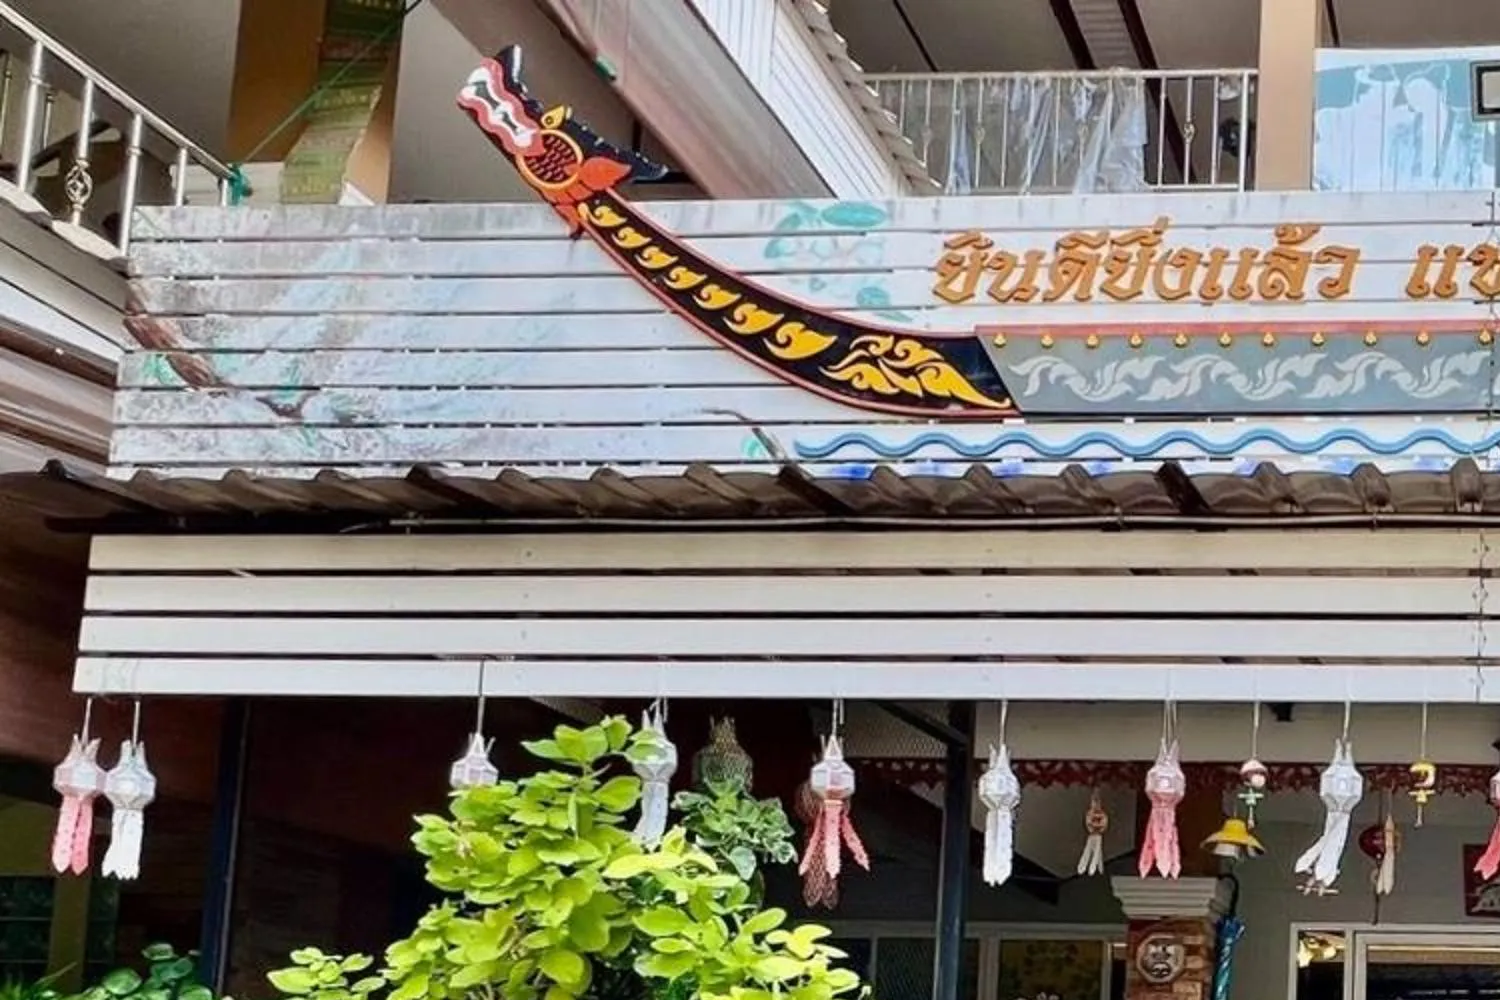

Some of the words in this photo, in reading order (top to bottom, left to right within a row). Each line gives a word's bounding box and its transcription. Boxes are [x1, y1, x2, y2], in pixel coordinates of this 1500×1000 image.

[933, 217, 1360, 303] ยินดียิ่งแล้ว
